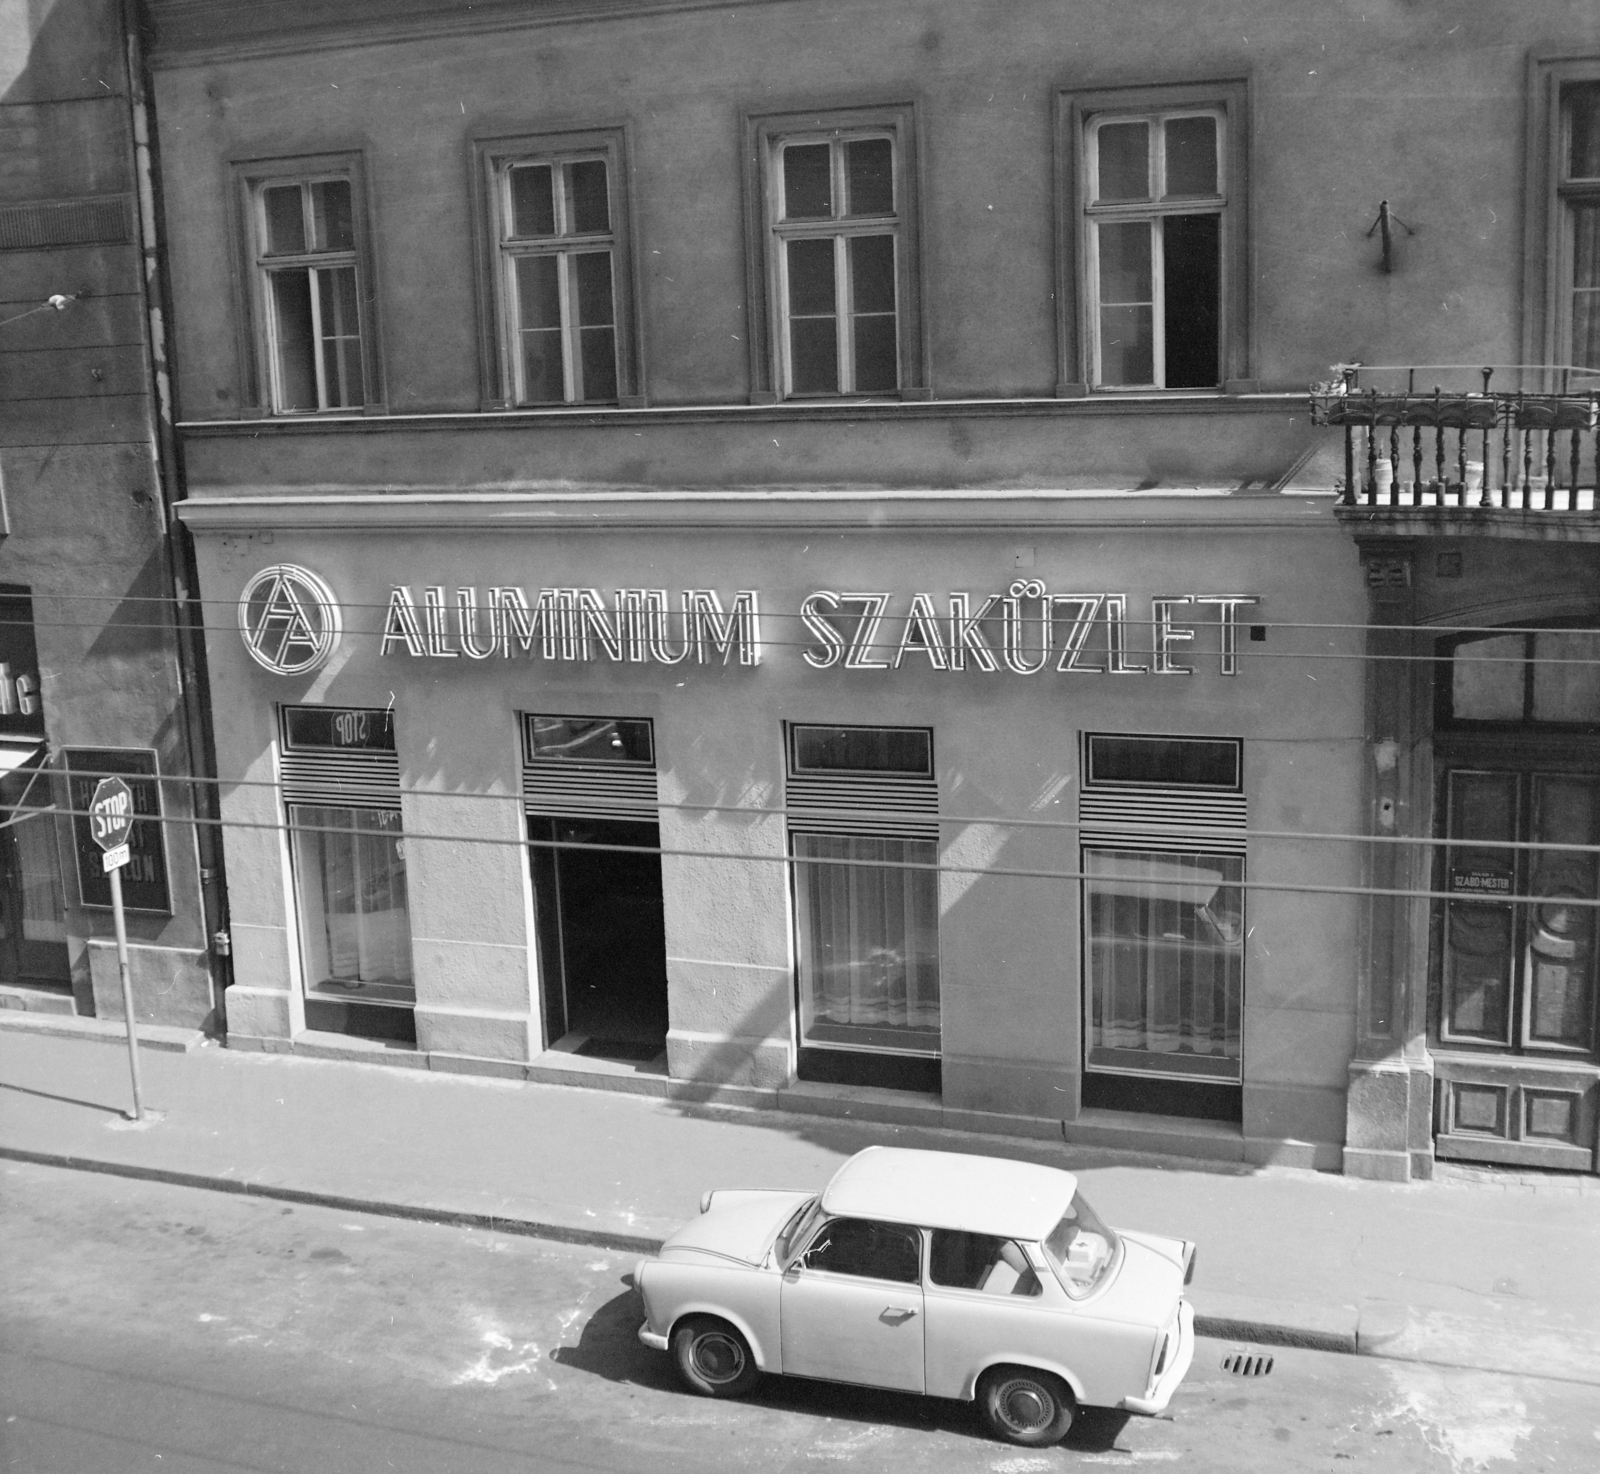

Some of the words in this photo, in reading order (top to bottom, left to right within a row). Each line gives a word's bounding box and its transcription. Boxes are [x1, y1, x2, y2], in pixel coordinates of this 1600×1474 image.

[381, 585, 763, 667] ALUMINIUM
[801, 578, 1262, 676] SZAKÜZLET
[94, 791, 128, 838] STOP
